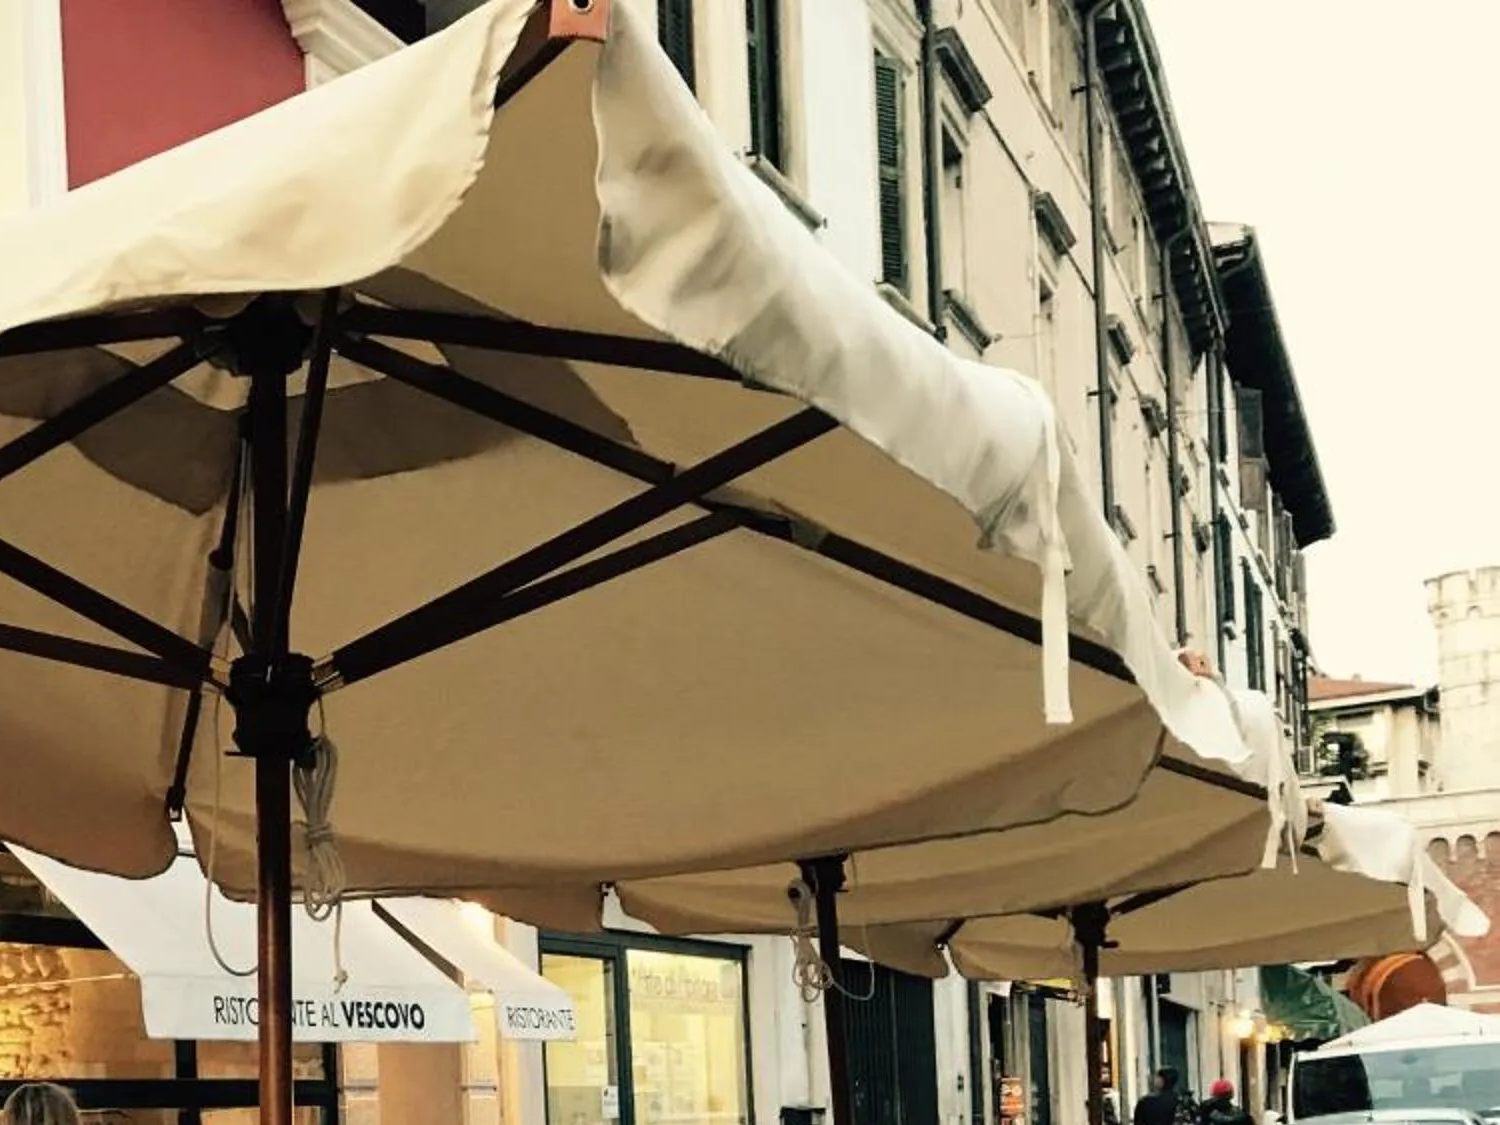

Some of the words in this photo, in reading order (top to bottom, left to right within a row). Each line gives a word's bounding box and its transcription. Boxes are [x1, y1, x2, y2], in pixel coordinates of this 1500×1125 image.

[213, 995, 316, 1027] RISTOTE
[321, 1001, 339, 1027] AL
[340, 1001, 425, 1031] VESCOVO
[505, 1006, 574, 1030] RISTORANTE
